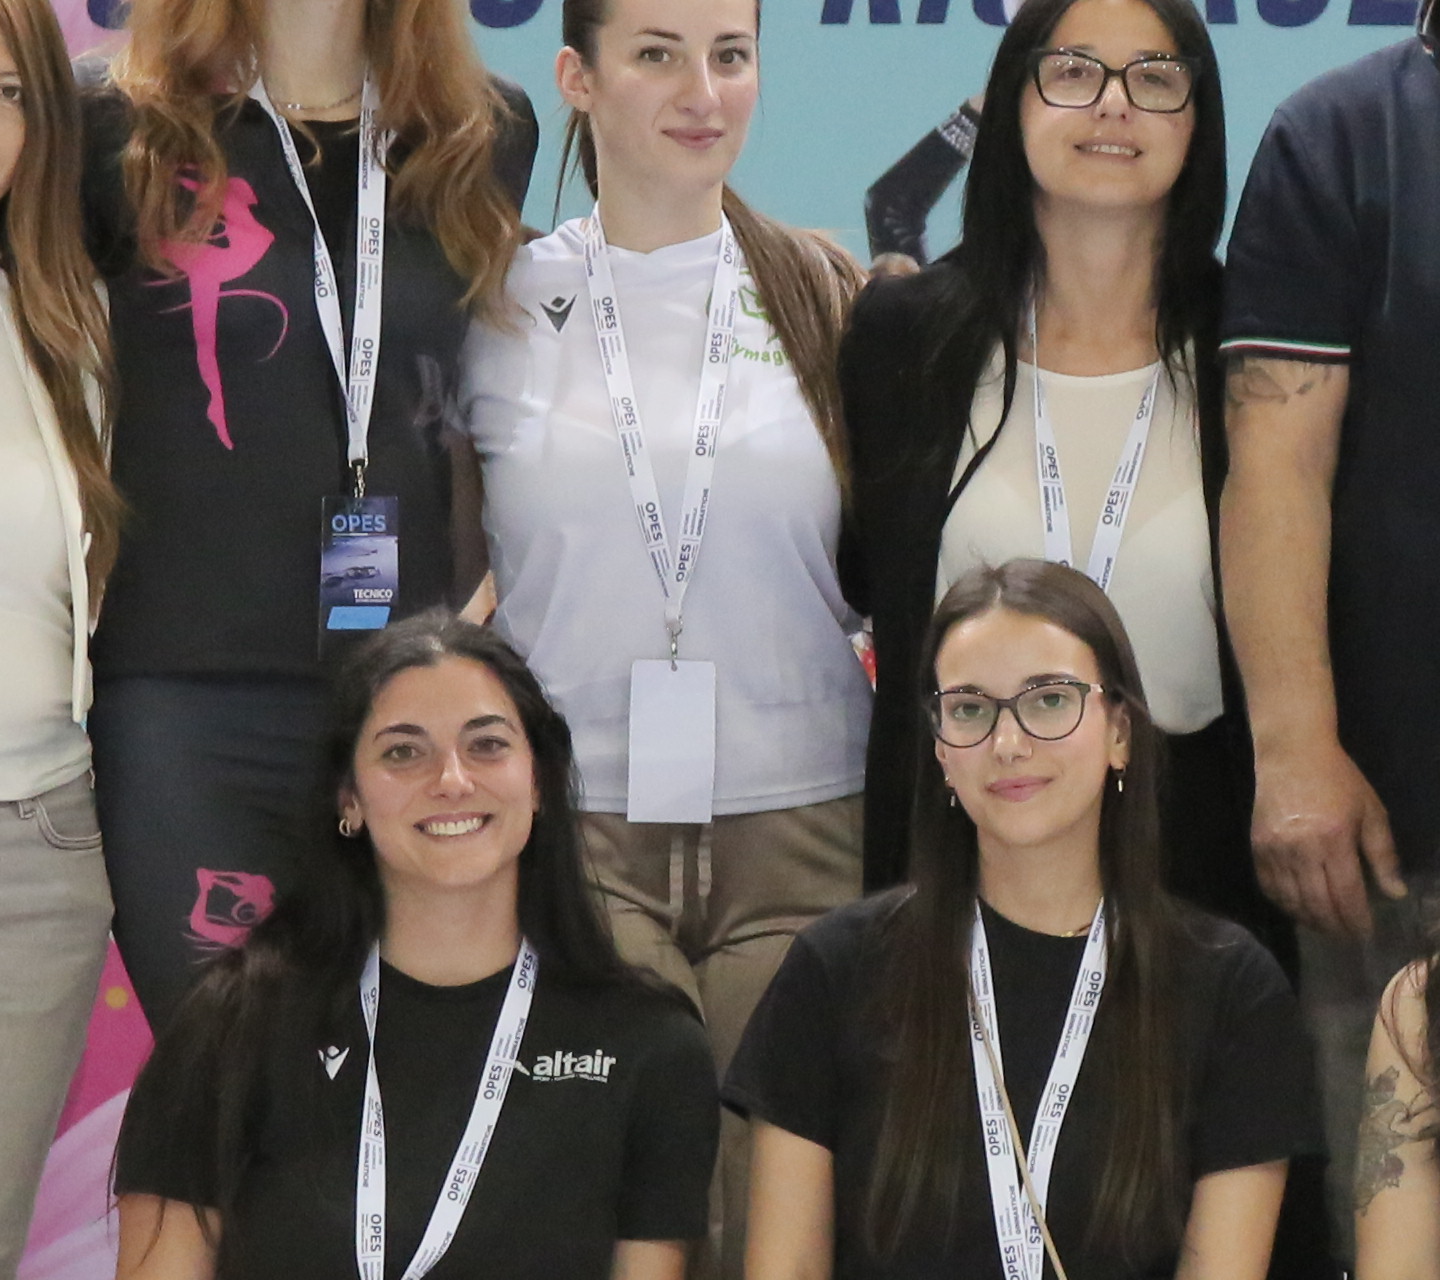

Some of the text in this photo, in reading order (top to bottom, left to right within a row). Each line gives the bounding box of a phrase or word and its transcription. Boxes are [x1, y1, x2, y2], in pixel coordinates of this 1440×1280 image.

[369, 218, 380, 255] OPES
[602, 297, 617, 329] OPES
[360, 339, 374, 376] OPES
[710, 333, 723, 363] OPES
[621, 397, 637, 426] OPES
[695, 425, 709, 456] OPES
[1046, 446, 1060, 479] OPES
[332, 515, 386, 532] OPES
[646, 502, 663, 541] OPES
[1102, 490, 1120, 525] OPES
[676, 544, 691, 582] OPES
[353, 589, 393, 599] TECNICO
[517, 952, 533, 989] OPES
[978, 948, 989, 995] GINNASTICHE
[1084, 972, 1102, 1007] OPES
[1060, 1013, 1076, 1059] GINNASTICHE
[532, 1049, 617, 1077] altair
[483, 1064, 502, 1100] OPES
[374, 1101, 383, 1137] OPES
[1050, 1084, 1069, 1118] OPES
[987, 1120, 1001, 1156] OPES
[1029, 1125, 1043, 1173] GINNASTICHE
[448, 1168, 468, 1201] OPES
[1009, 1185, 1021, 1235] GINNASTICHE
[370, 1214, 382, 1252] OPES
